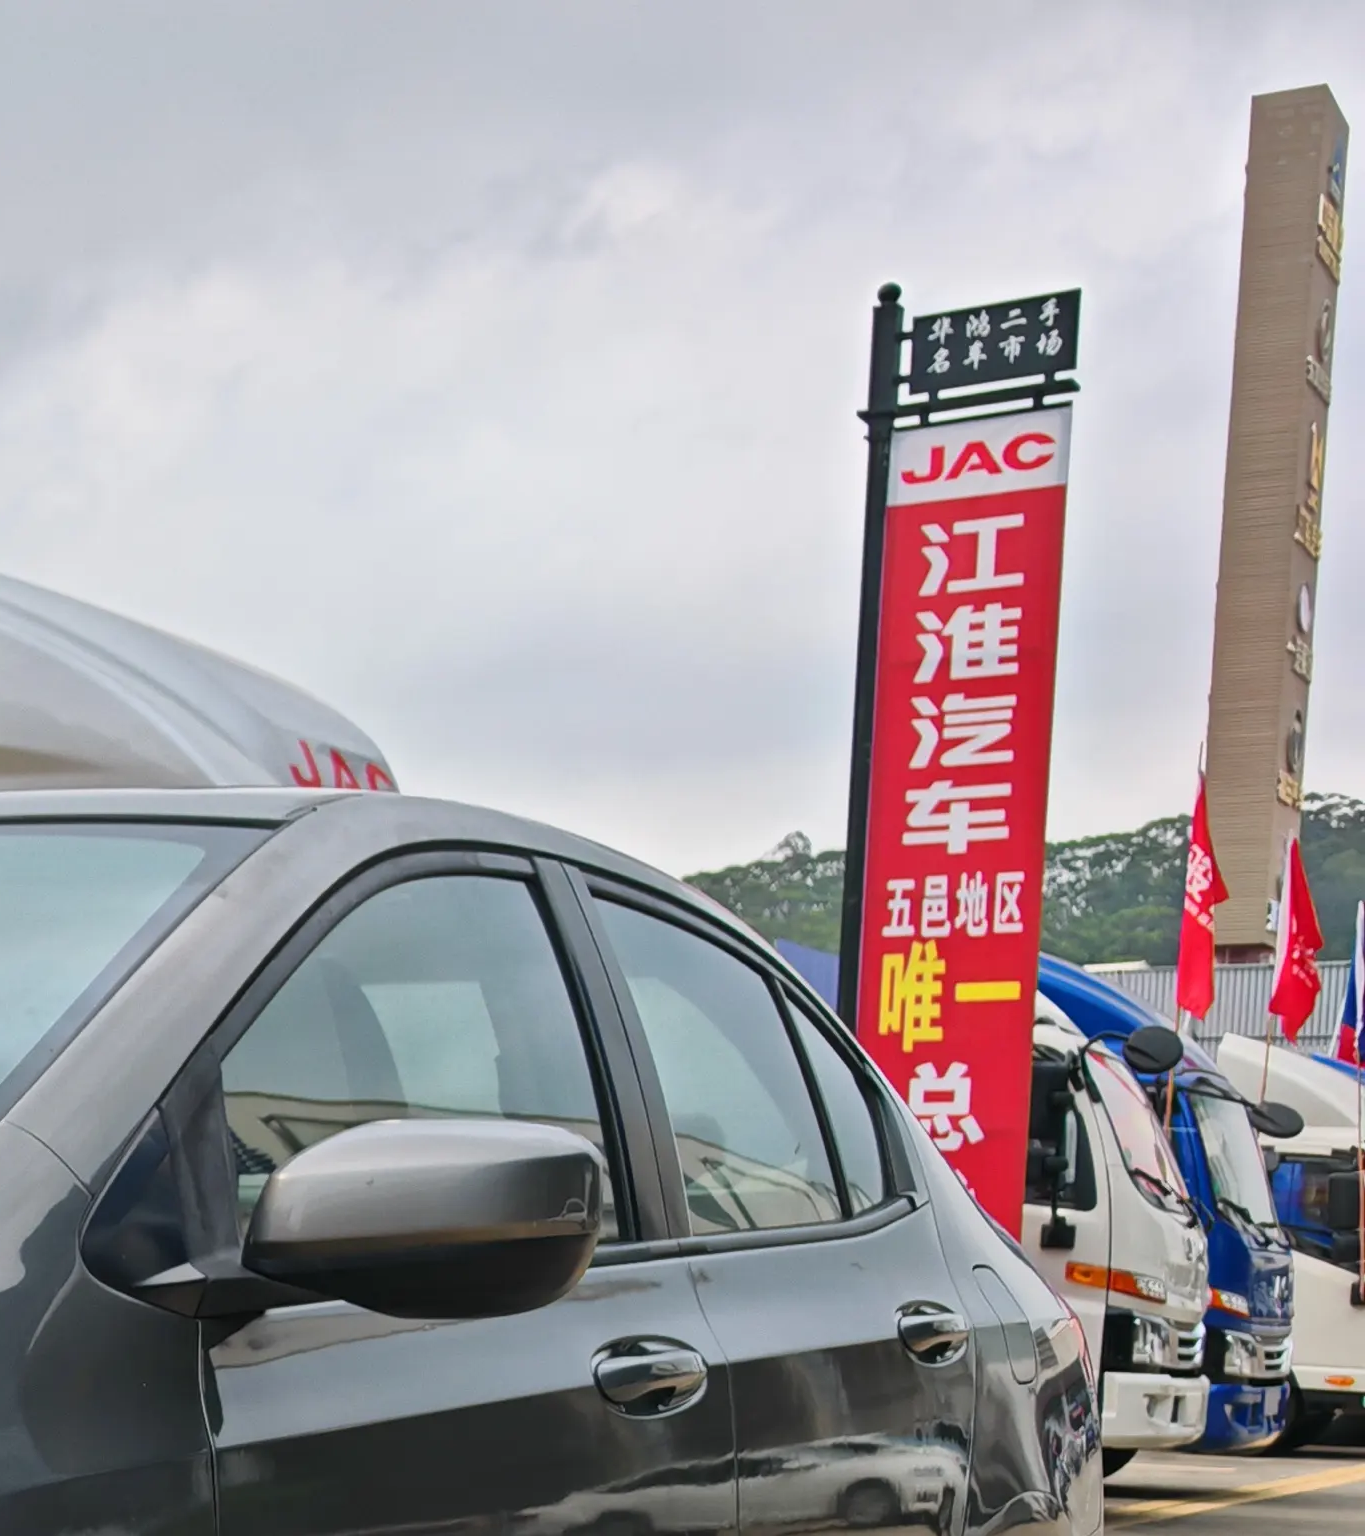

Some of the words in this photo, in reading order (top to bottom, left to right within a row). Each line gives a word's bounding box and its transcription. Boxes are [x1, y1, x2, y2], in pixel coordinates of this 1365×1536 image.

[926, 328, 1063, 374] 名车市场
[927, 297, 1060, 345] 华鸿二手
[901, 432, 1057, 485] JAC
[901, 512, 1026, 856] 江淮汽车
[882, 871, 1025, 937] 五邑地区
[878, 939, 1021, 1053] 唯一
[908, 1060, 985, 1202] 总
